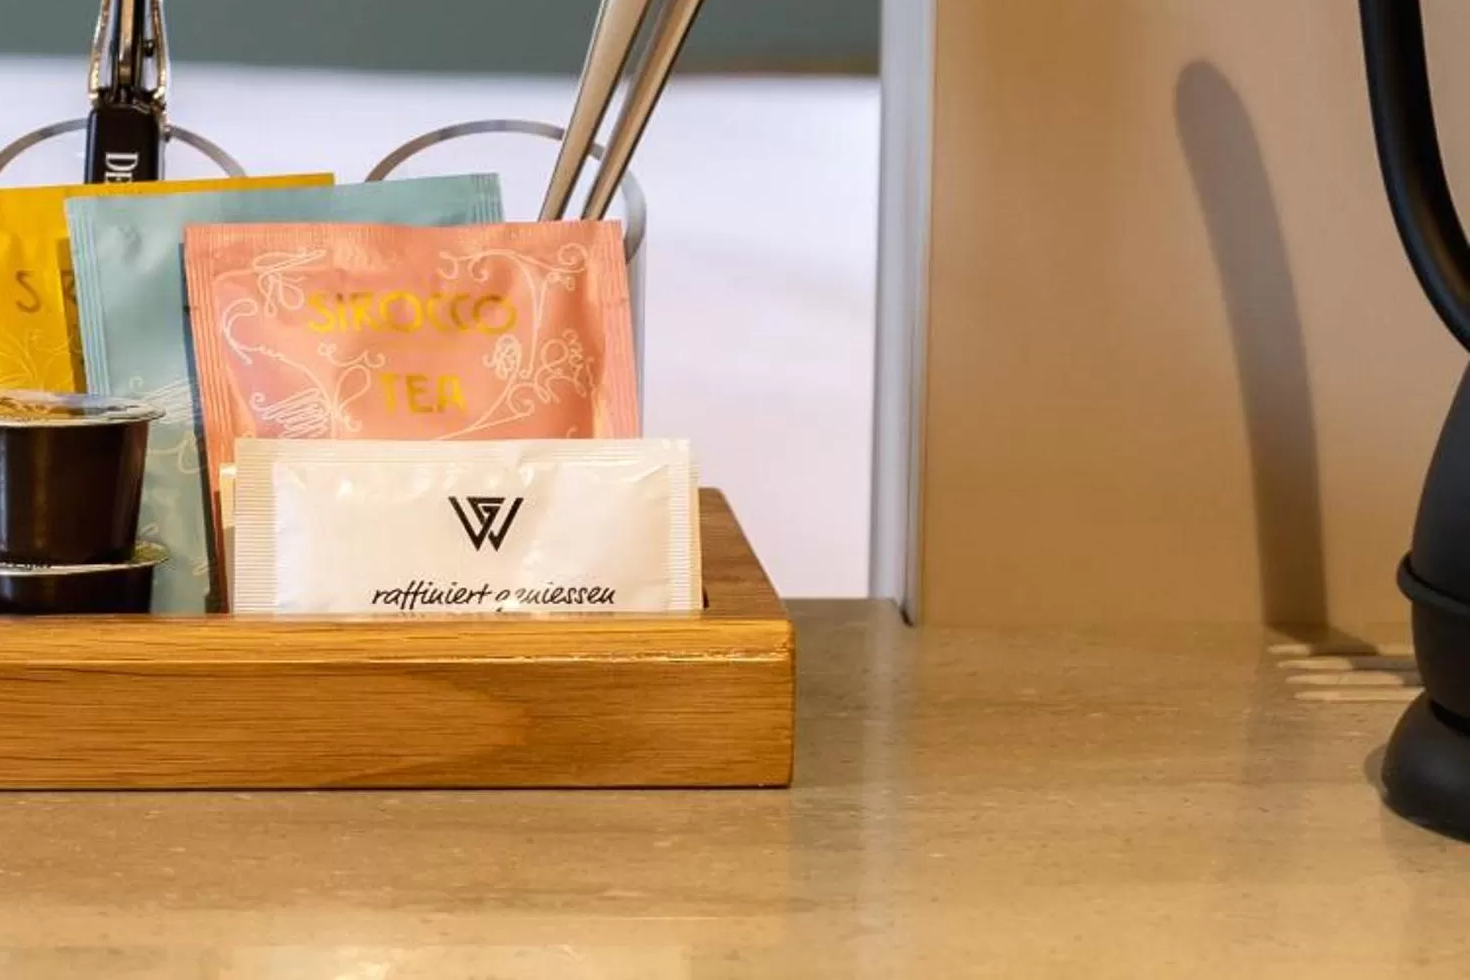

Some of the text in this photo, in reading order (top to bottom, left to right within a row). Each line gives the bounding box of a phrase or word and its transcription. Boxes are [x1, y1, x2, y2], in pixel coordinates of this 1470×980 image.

[308, 290, 517, 334] SIROCCO
[381, 373, 467, 414] TEA
[372, 580, 492, 611] raffiniert
